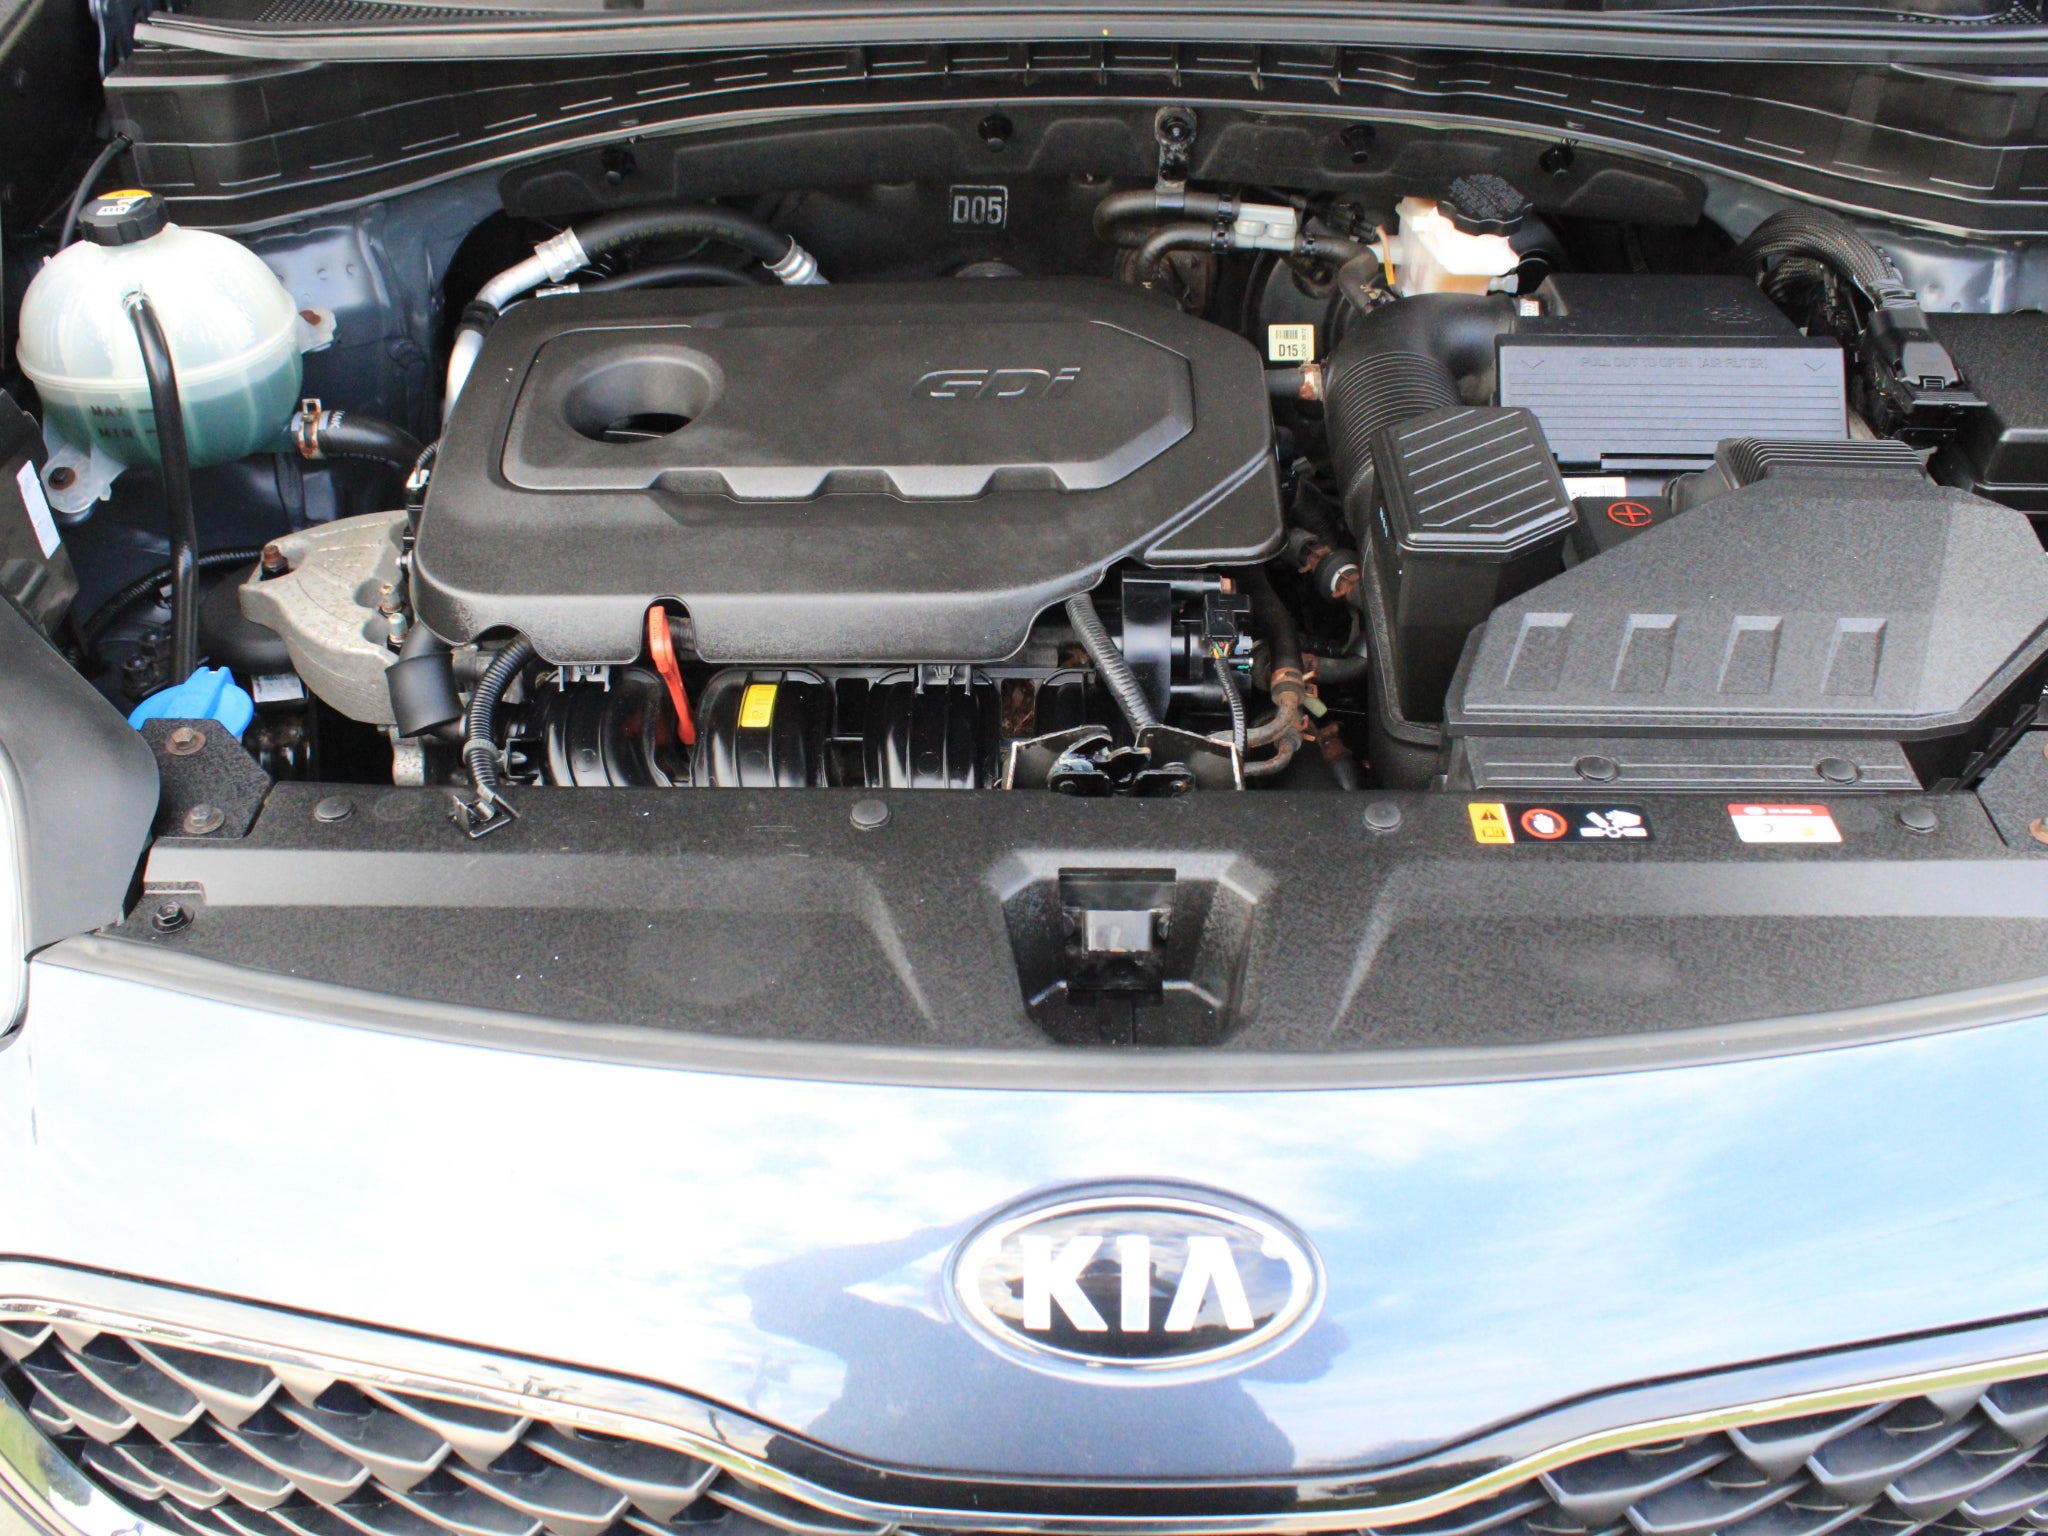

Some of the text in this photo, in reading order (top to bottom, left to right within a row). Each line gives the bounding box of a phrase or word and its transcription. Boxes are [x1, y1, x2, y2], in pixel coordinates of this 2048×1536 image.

[1278, 344, 1299, 357] D15
[1580, 357, 1611, 367] PULL
[910, 368, 1081, 400] GDi
[90, 406, 125, 416] MAX
[98, 427, 133, 437] MIN
[1018, 1234, 1255, 1332] KIA
